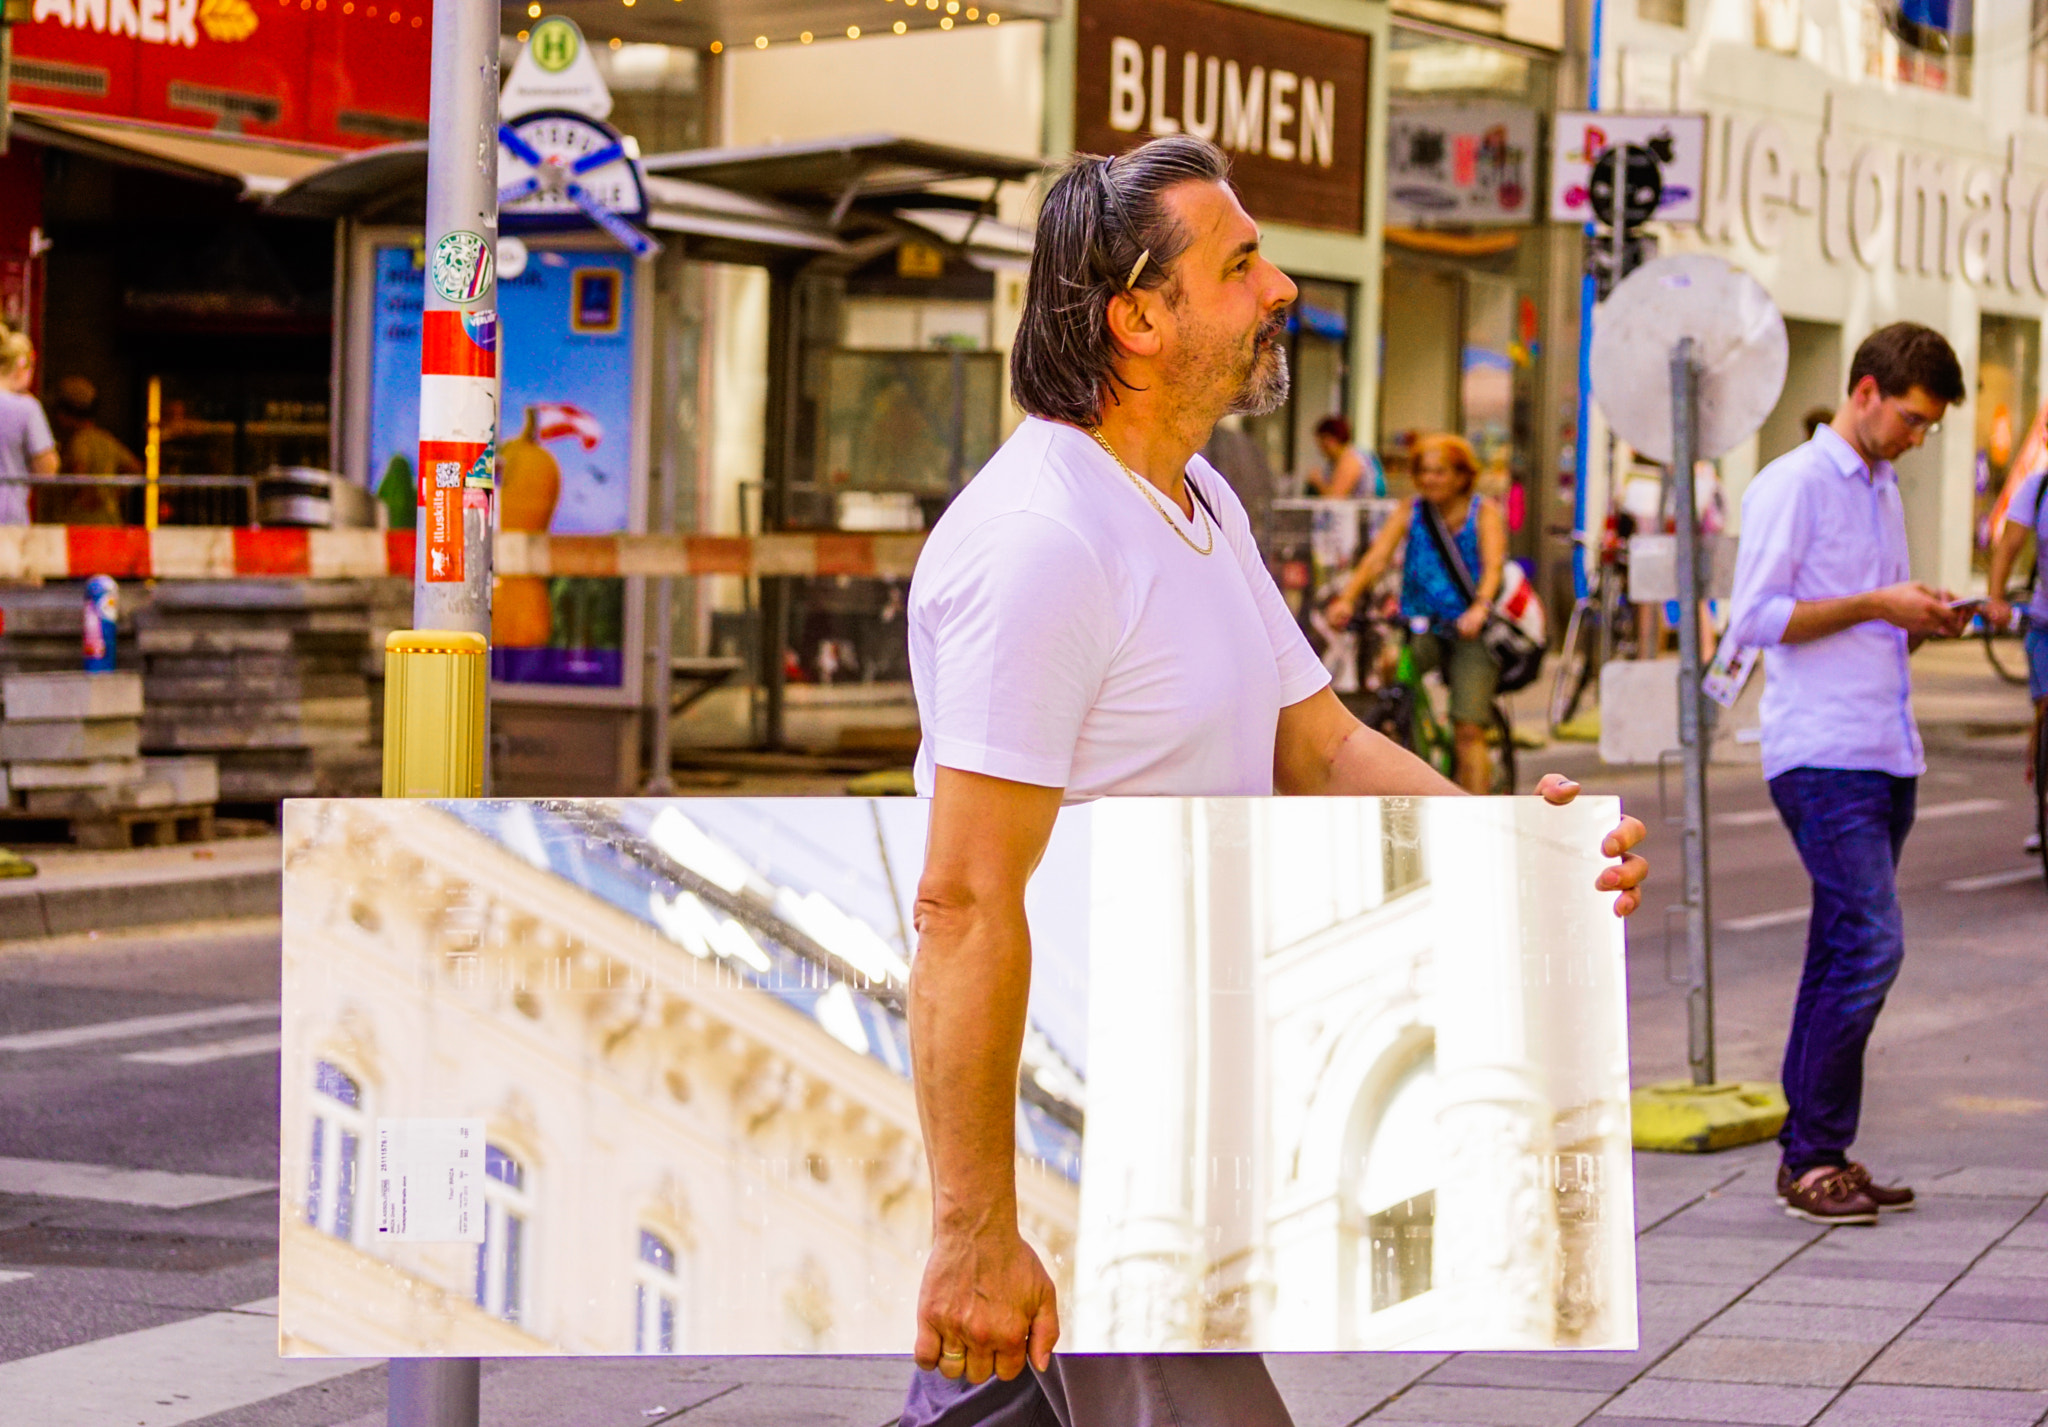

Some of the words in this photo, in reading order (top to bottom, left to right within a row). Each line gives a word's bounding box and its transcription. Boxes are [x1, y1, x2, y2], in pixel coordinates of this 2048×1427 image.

[543, 33, 567, 60] H
[1109, 36, 1336, 168] BLUMEN
[433, 490, 445, 543] illuskills
